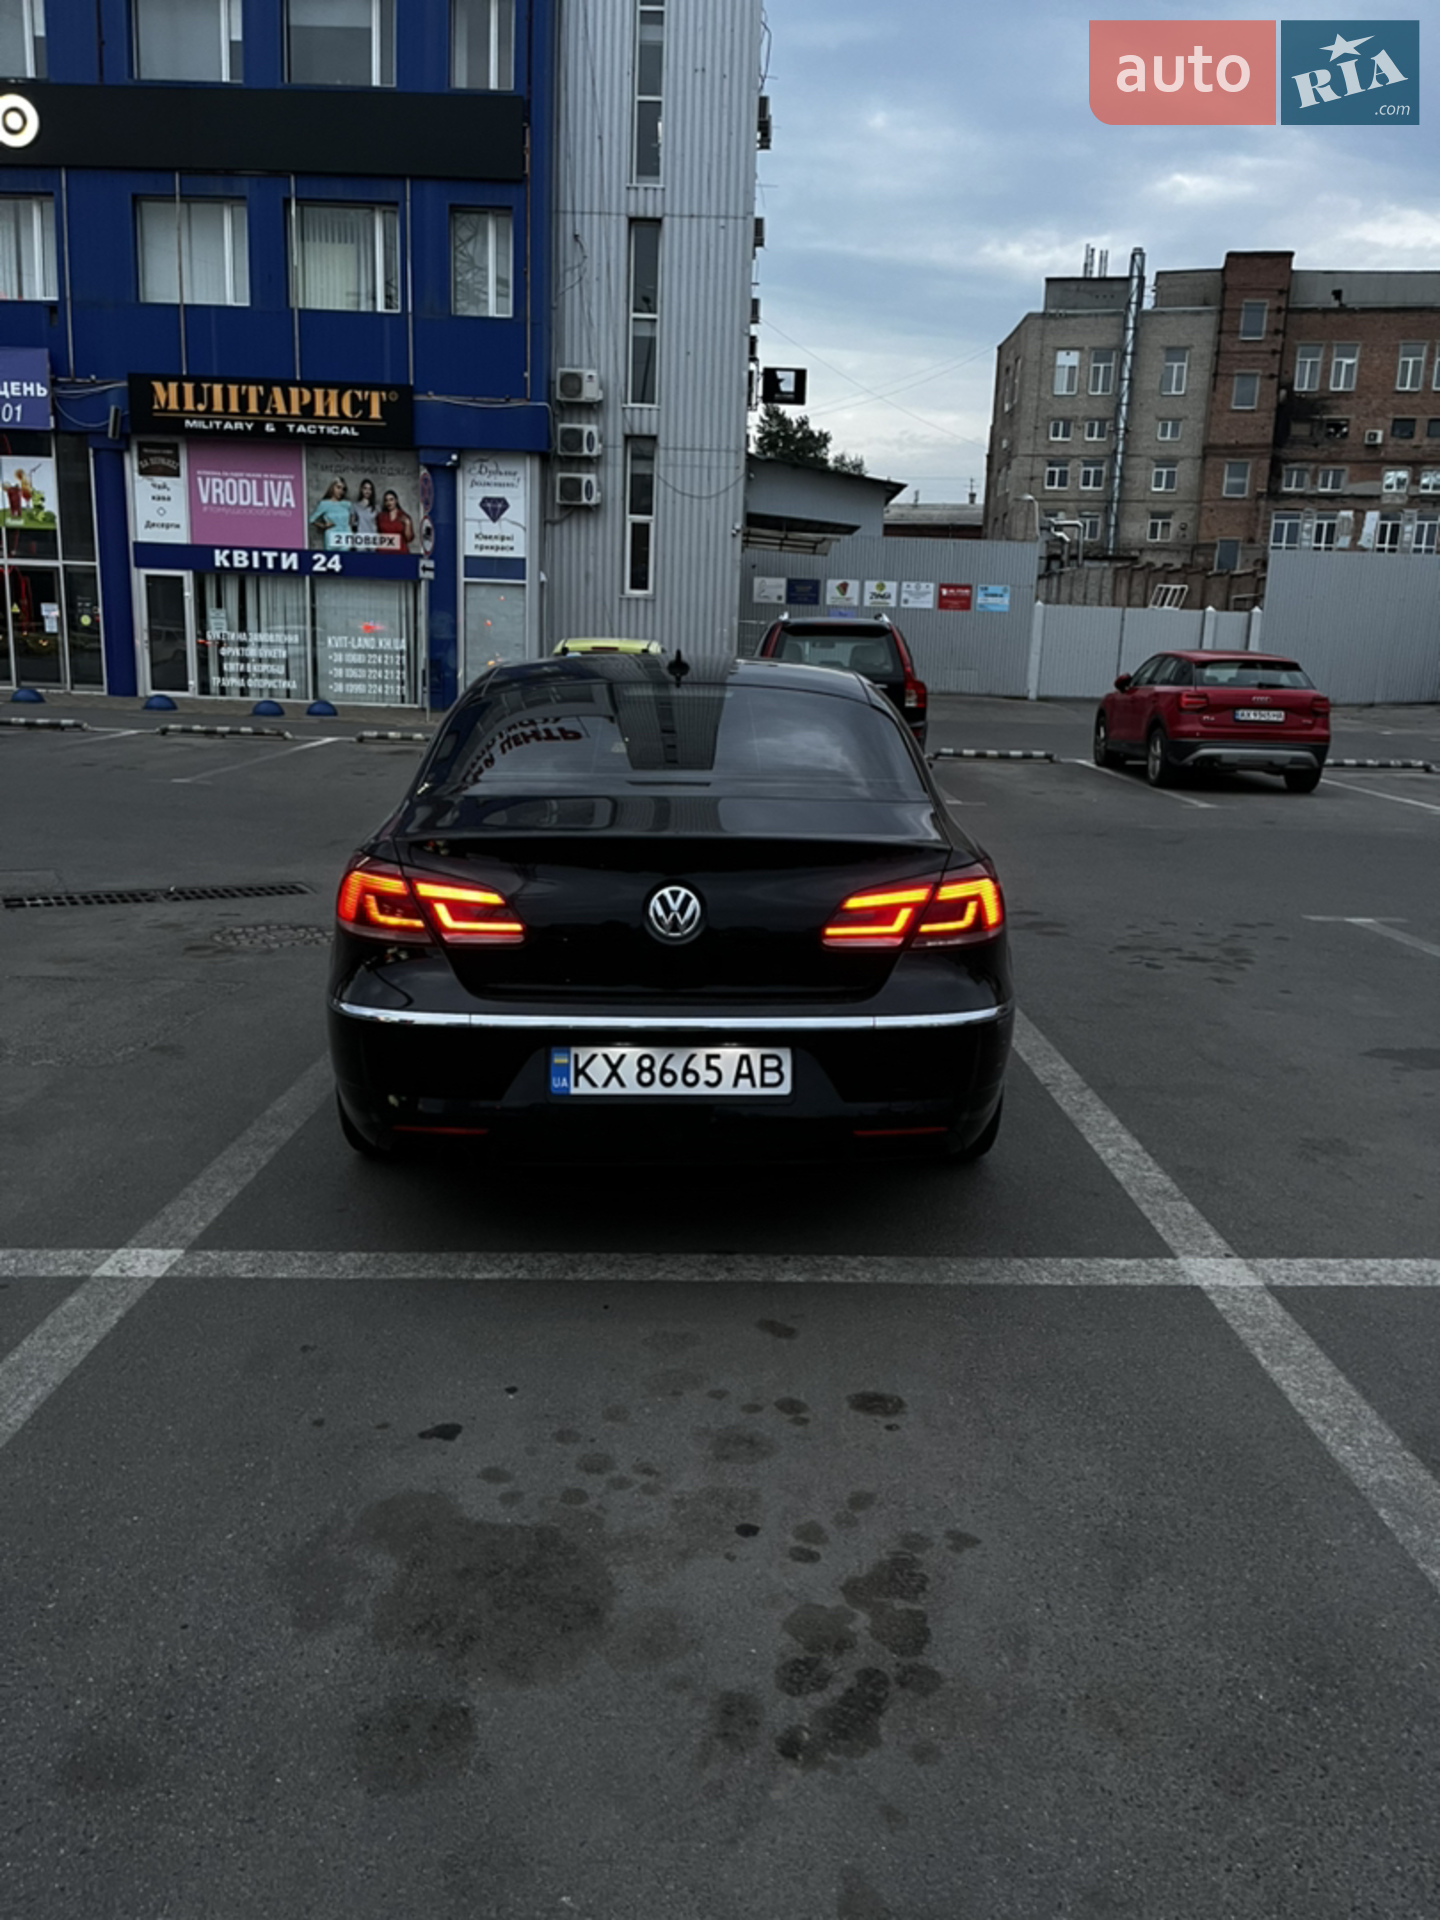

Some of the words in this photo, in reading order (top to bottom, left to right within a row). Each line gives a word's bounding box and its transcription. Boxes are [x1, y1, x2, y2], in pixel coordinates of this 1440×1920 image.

[184, 419, 254, 432] MILITARY
[265, 423, 276, 433] &
[286, 424, 360, 436] TACTICAL
[197, 476, 296, 509] VRODLIVA
[334, 534, 343, 545] 2
[345, 534, 396, 546] ПОВЕРХ
[213, 548, 299, 571] КВІТИ
[312, 553, 343, 573] 24
[573, 1053, 627, 1088] KX
[636, 1053, 723, 1088] 8665
[732, 1053, 785, 1088] AB
[552, 1077, 568, 1088] UA
